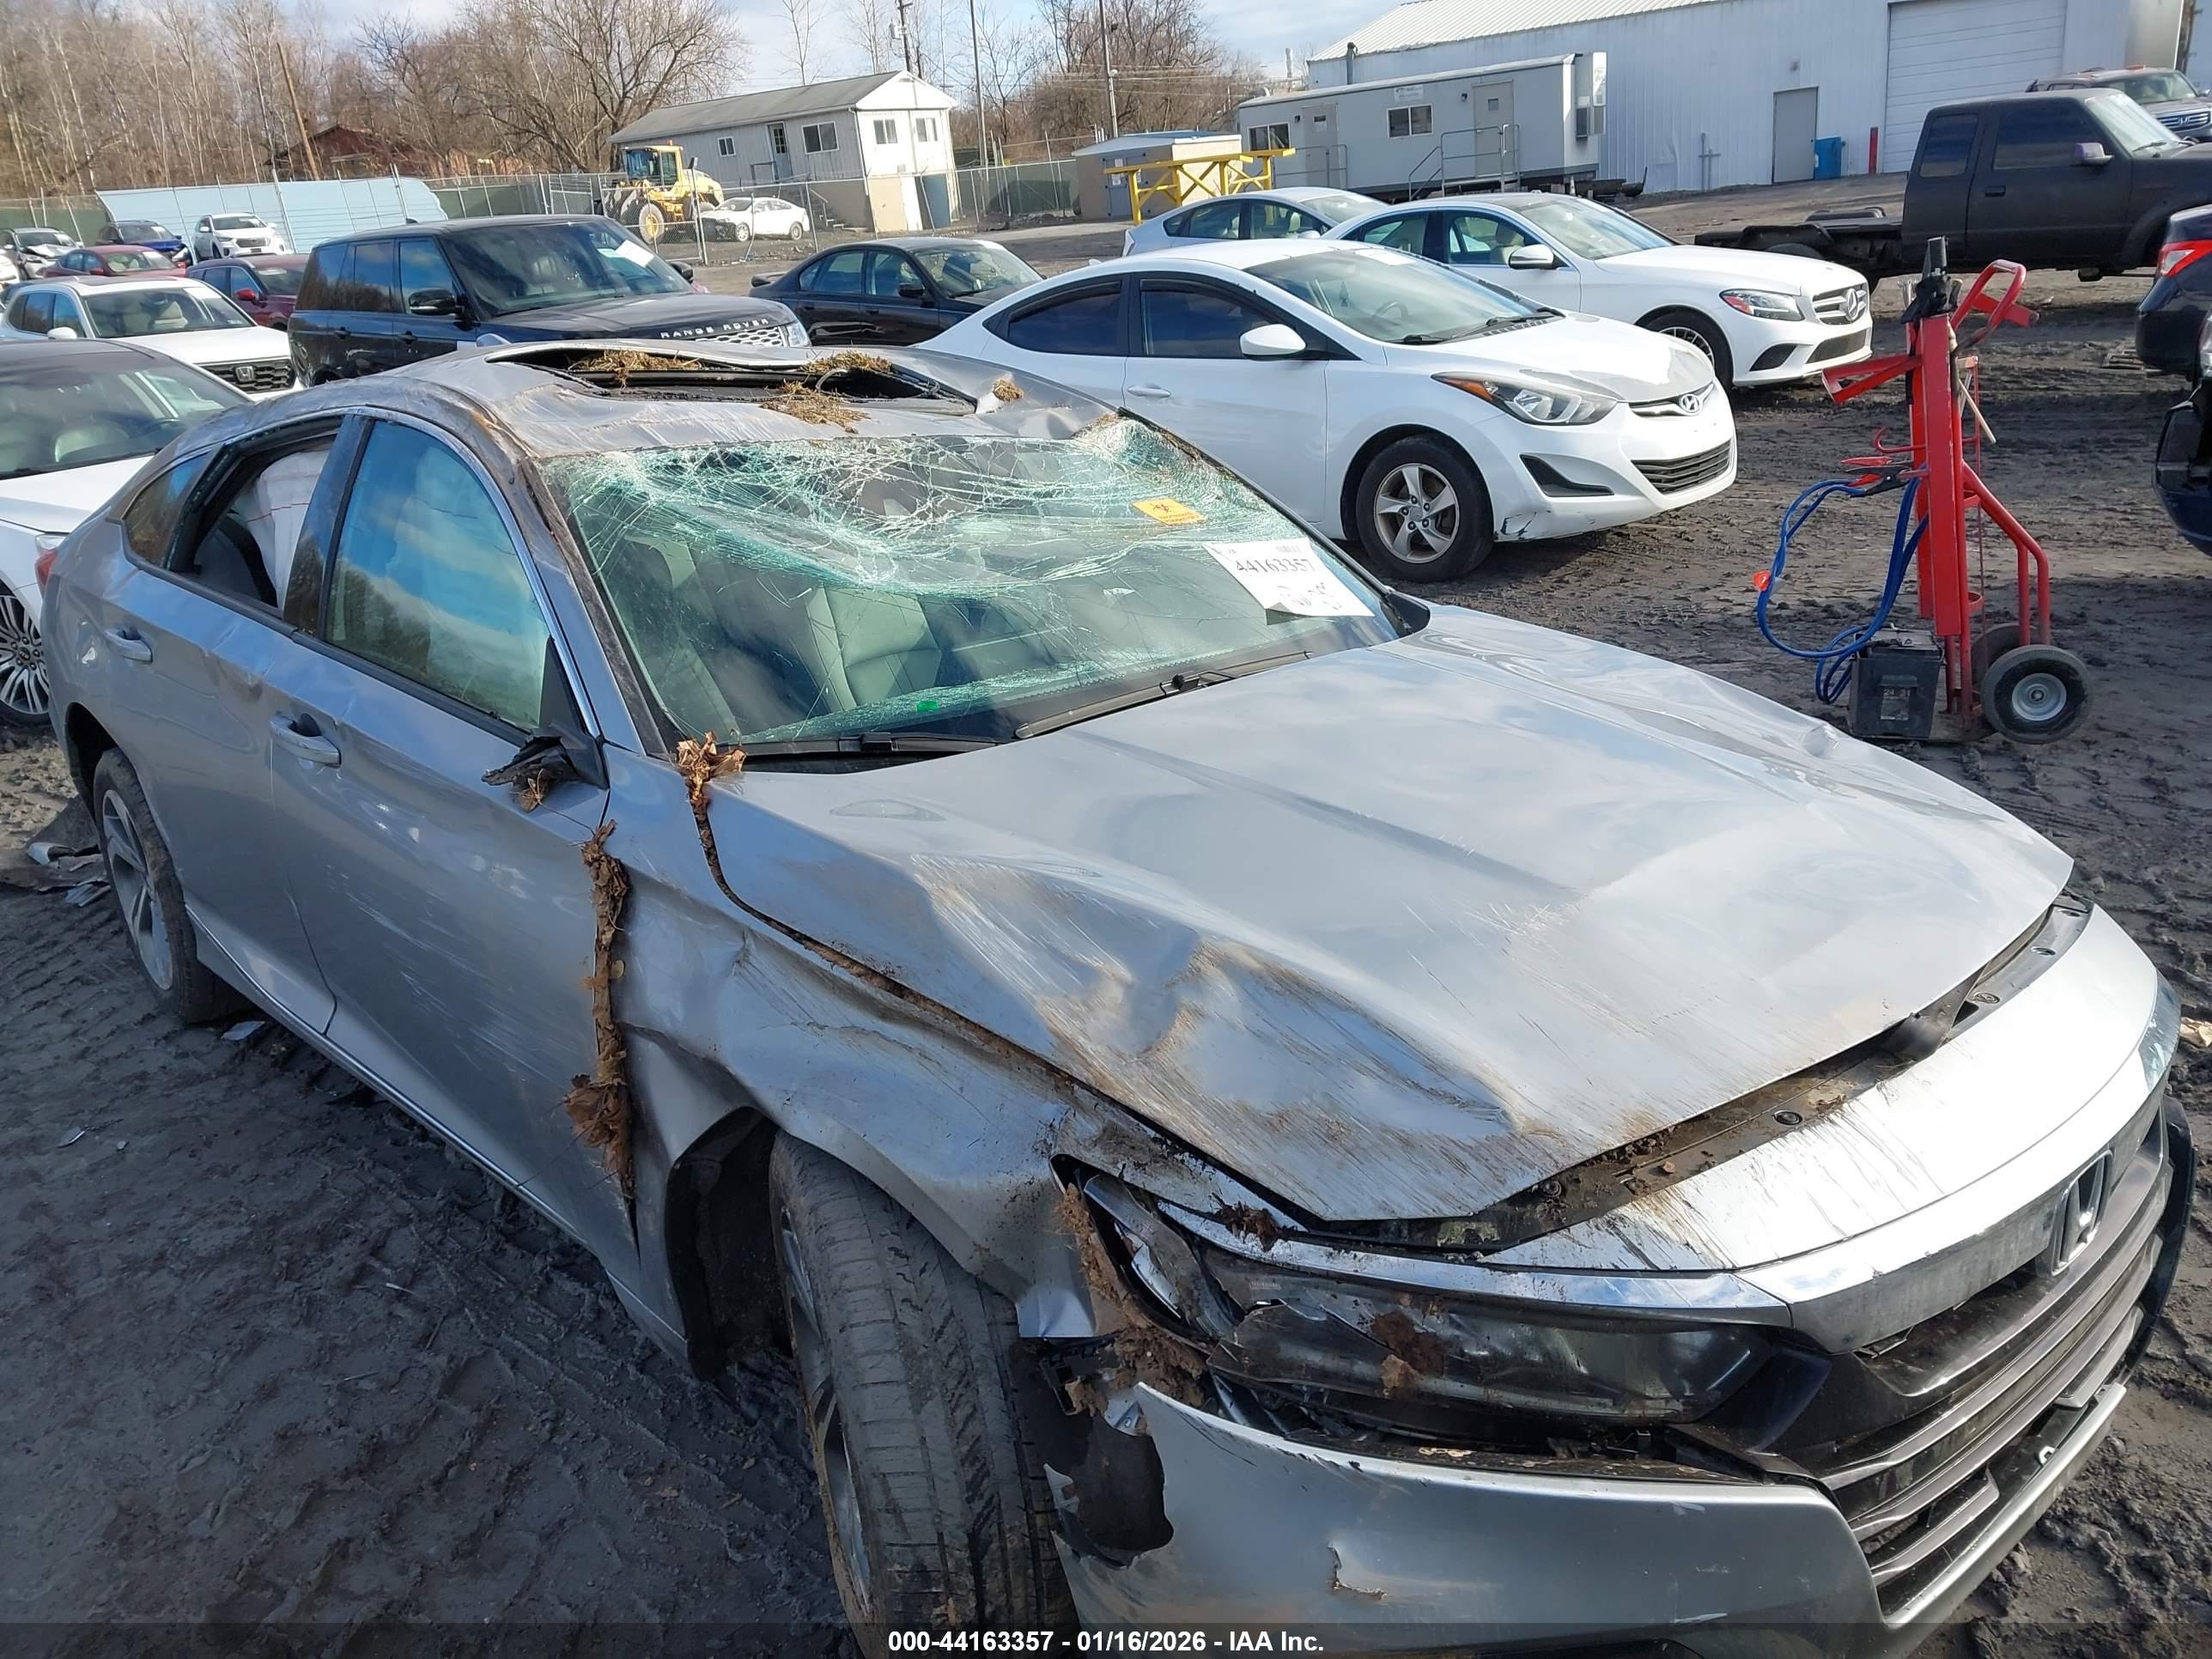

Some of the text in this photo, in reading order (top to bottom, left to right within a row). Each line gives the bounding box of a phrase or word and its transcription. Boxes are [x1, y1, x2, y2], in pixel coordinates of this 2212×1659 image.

[659, 318, 769, 339] RANGE ROVER
[1236, 558, 1316, 573] 44163357
